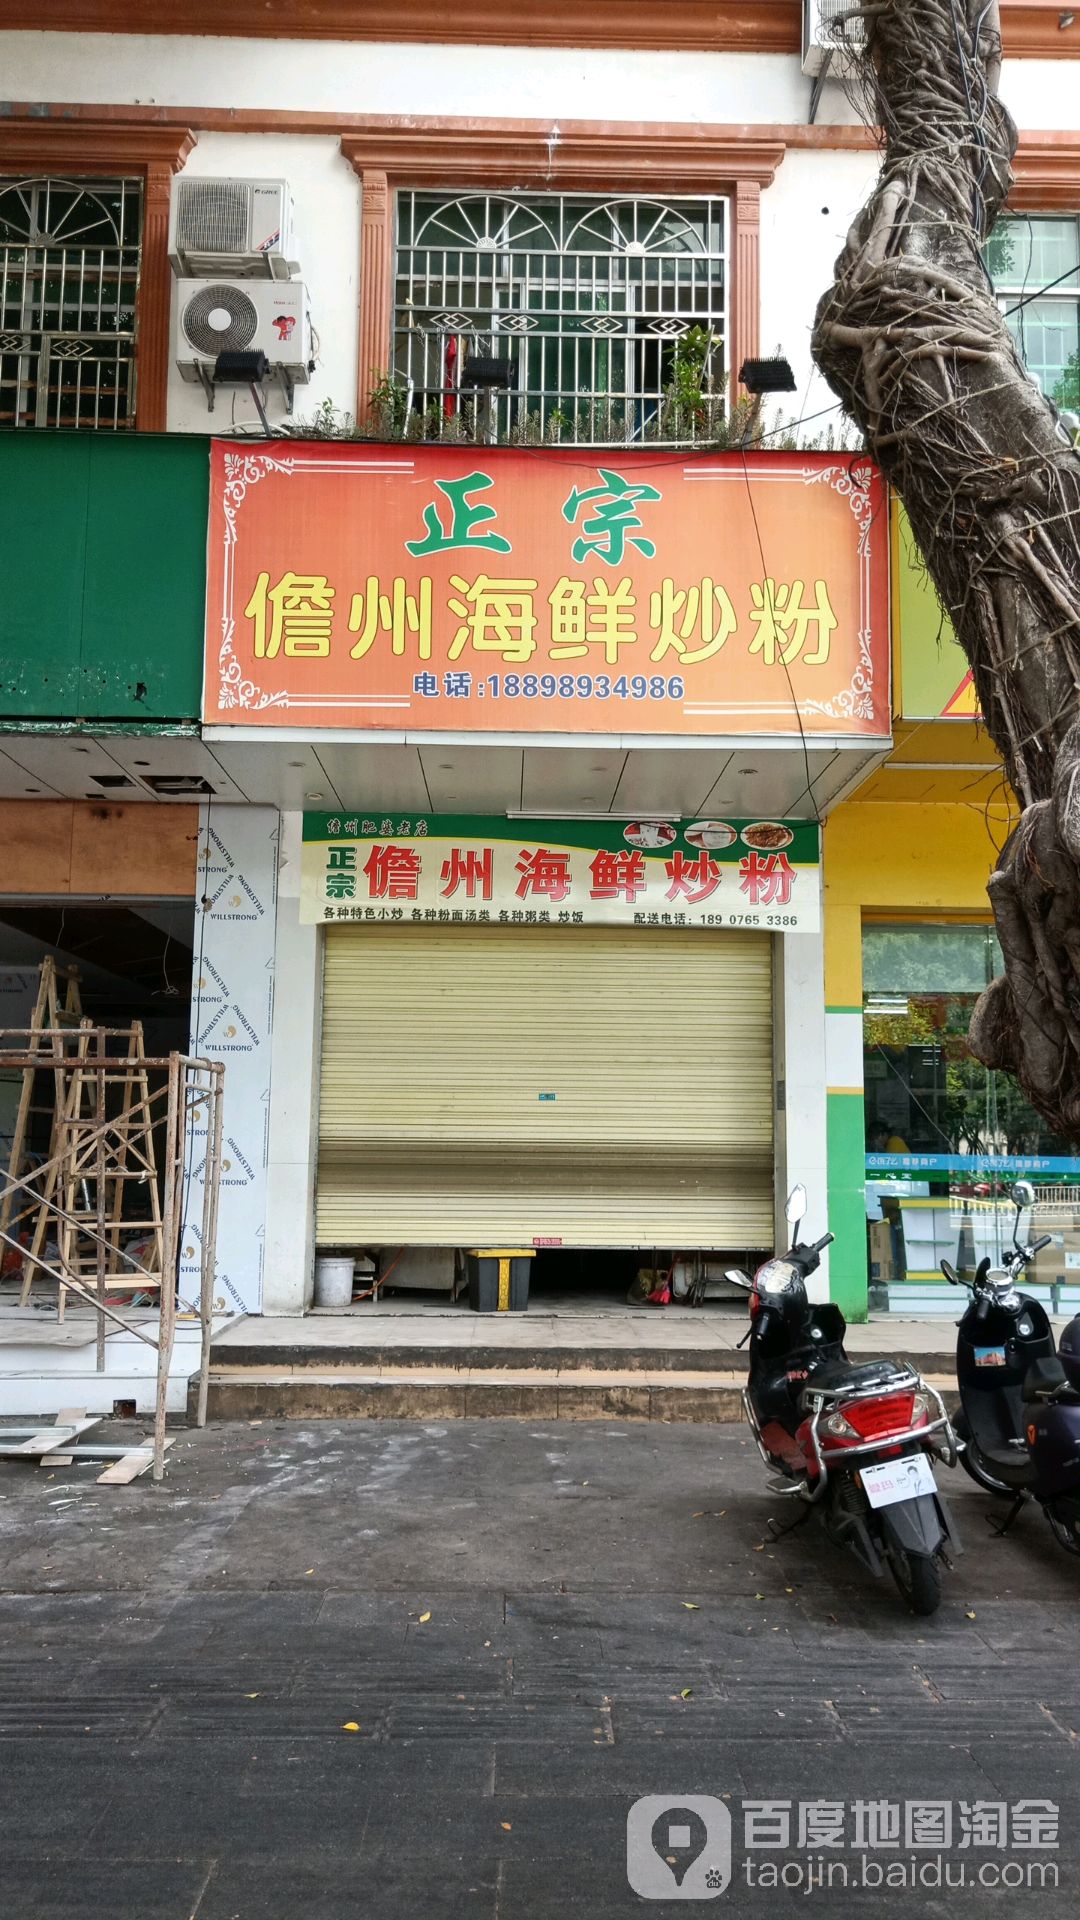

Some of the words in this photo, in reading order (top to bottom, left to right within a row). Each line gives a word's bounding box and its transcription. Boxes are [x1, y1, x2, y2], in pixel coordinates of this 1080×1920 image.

[405, 469, 663, 566] 正宗
[244, 571, 839, 666] 儋州海鲜炒粉
[208, 827, 235, 868] WILLSTRONG
[211, 874, 234, 905] WILLSTRO
[326, 846, 357, 899] 正宗
[362, 844, 798, 905] 儋州海鲜炒粉
[237, 874, 265, 915] WILLSTRONG
[323, 906, 404, 920] 各种特色小炒
[411, 908, 490, 922] 各种粉面汤类
[498, 909, 550, 923] 各种粥类
[558, 910, 584, 923] 炒饭
[700, 915, 722, 925] 189
[729, 915, 760, 925] 0765
[766, 915, 798, 926] 3386
[202, 956, 230, 998] WILLSTRONG
[198, 1004, 229, 1044] WILLSTRONG
[232, 1005, 260, 1046] WILLSTRONG
[205, 1044, 253, 1052] WILLSTRONG
[227, 1137, 255, 1181] WILLSTRONG
